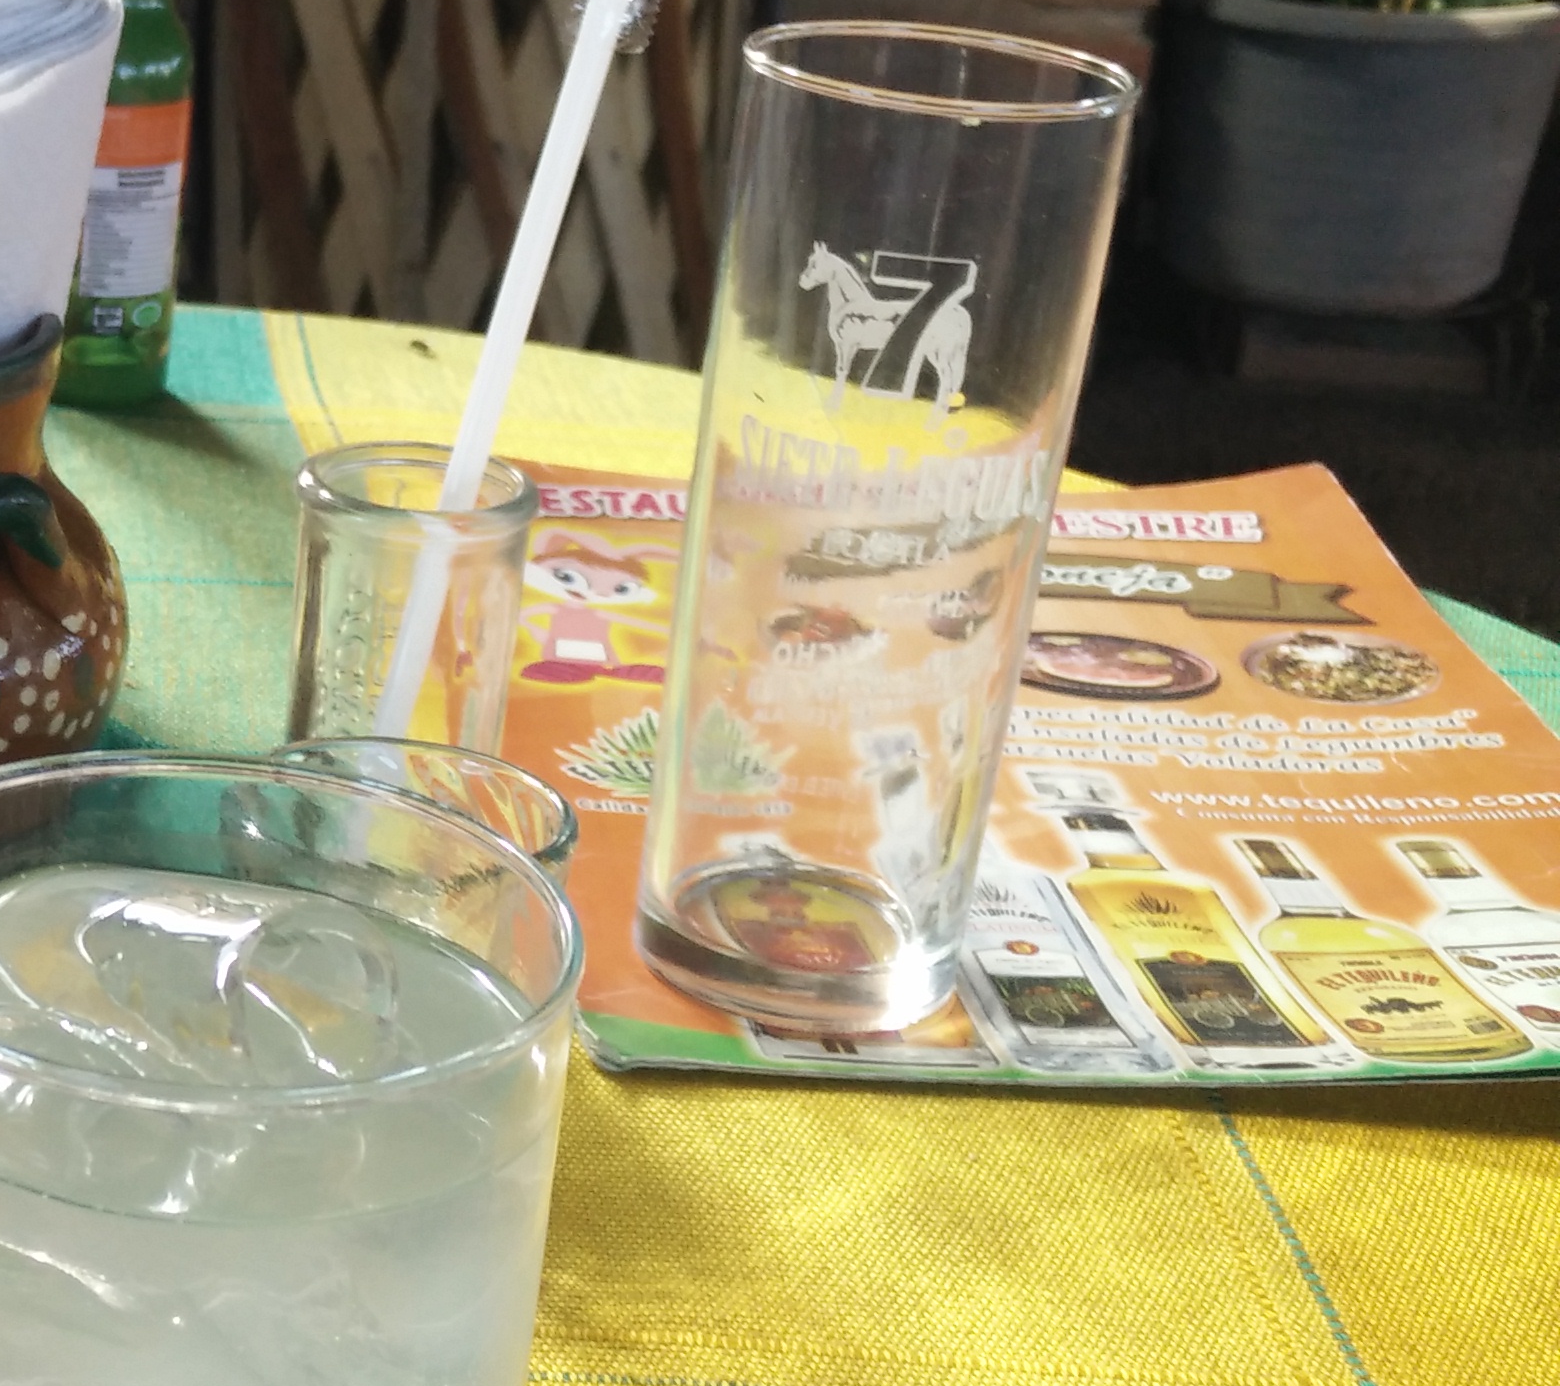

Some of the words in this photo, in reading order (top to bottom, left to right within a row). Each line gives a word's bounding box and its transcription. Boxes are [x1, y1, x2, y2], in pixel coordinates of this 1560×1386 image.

[1240, 713, 1289, 732] de
[1215, 733, 1269, 751] de
[1276, 732, 1507, 757] Legumbres
[1003, 743, 1159, 767] azuelas
[1162, 749, 1385, 773] Voladoras
[576, 796, 651, 815] Calida
